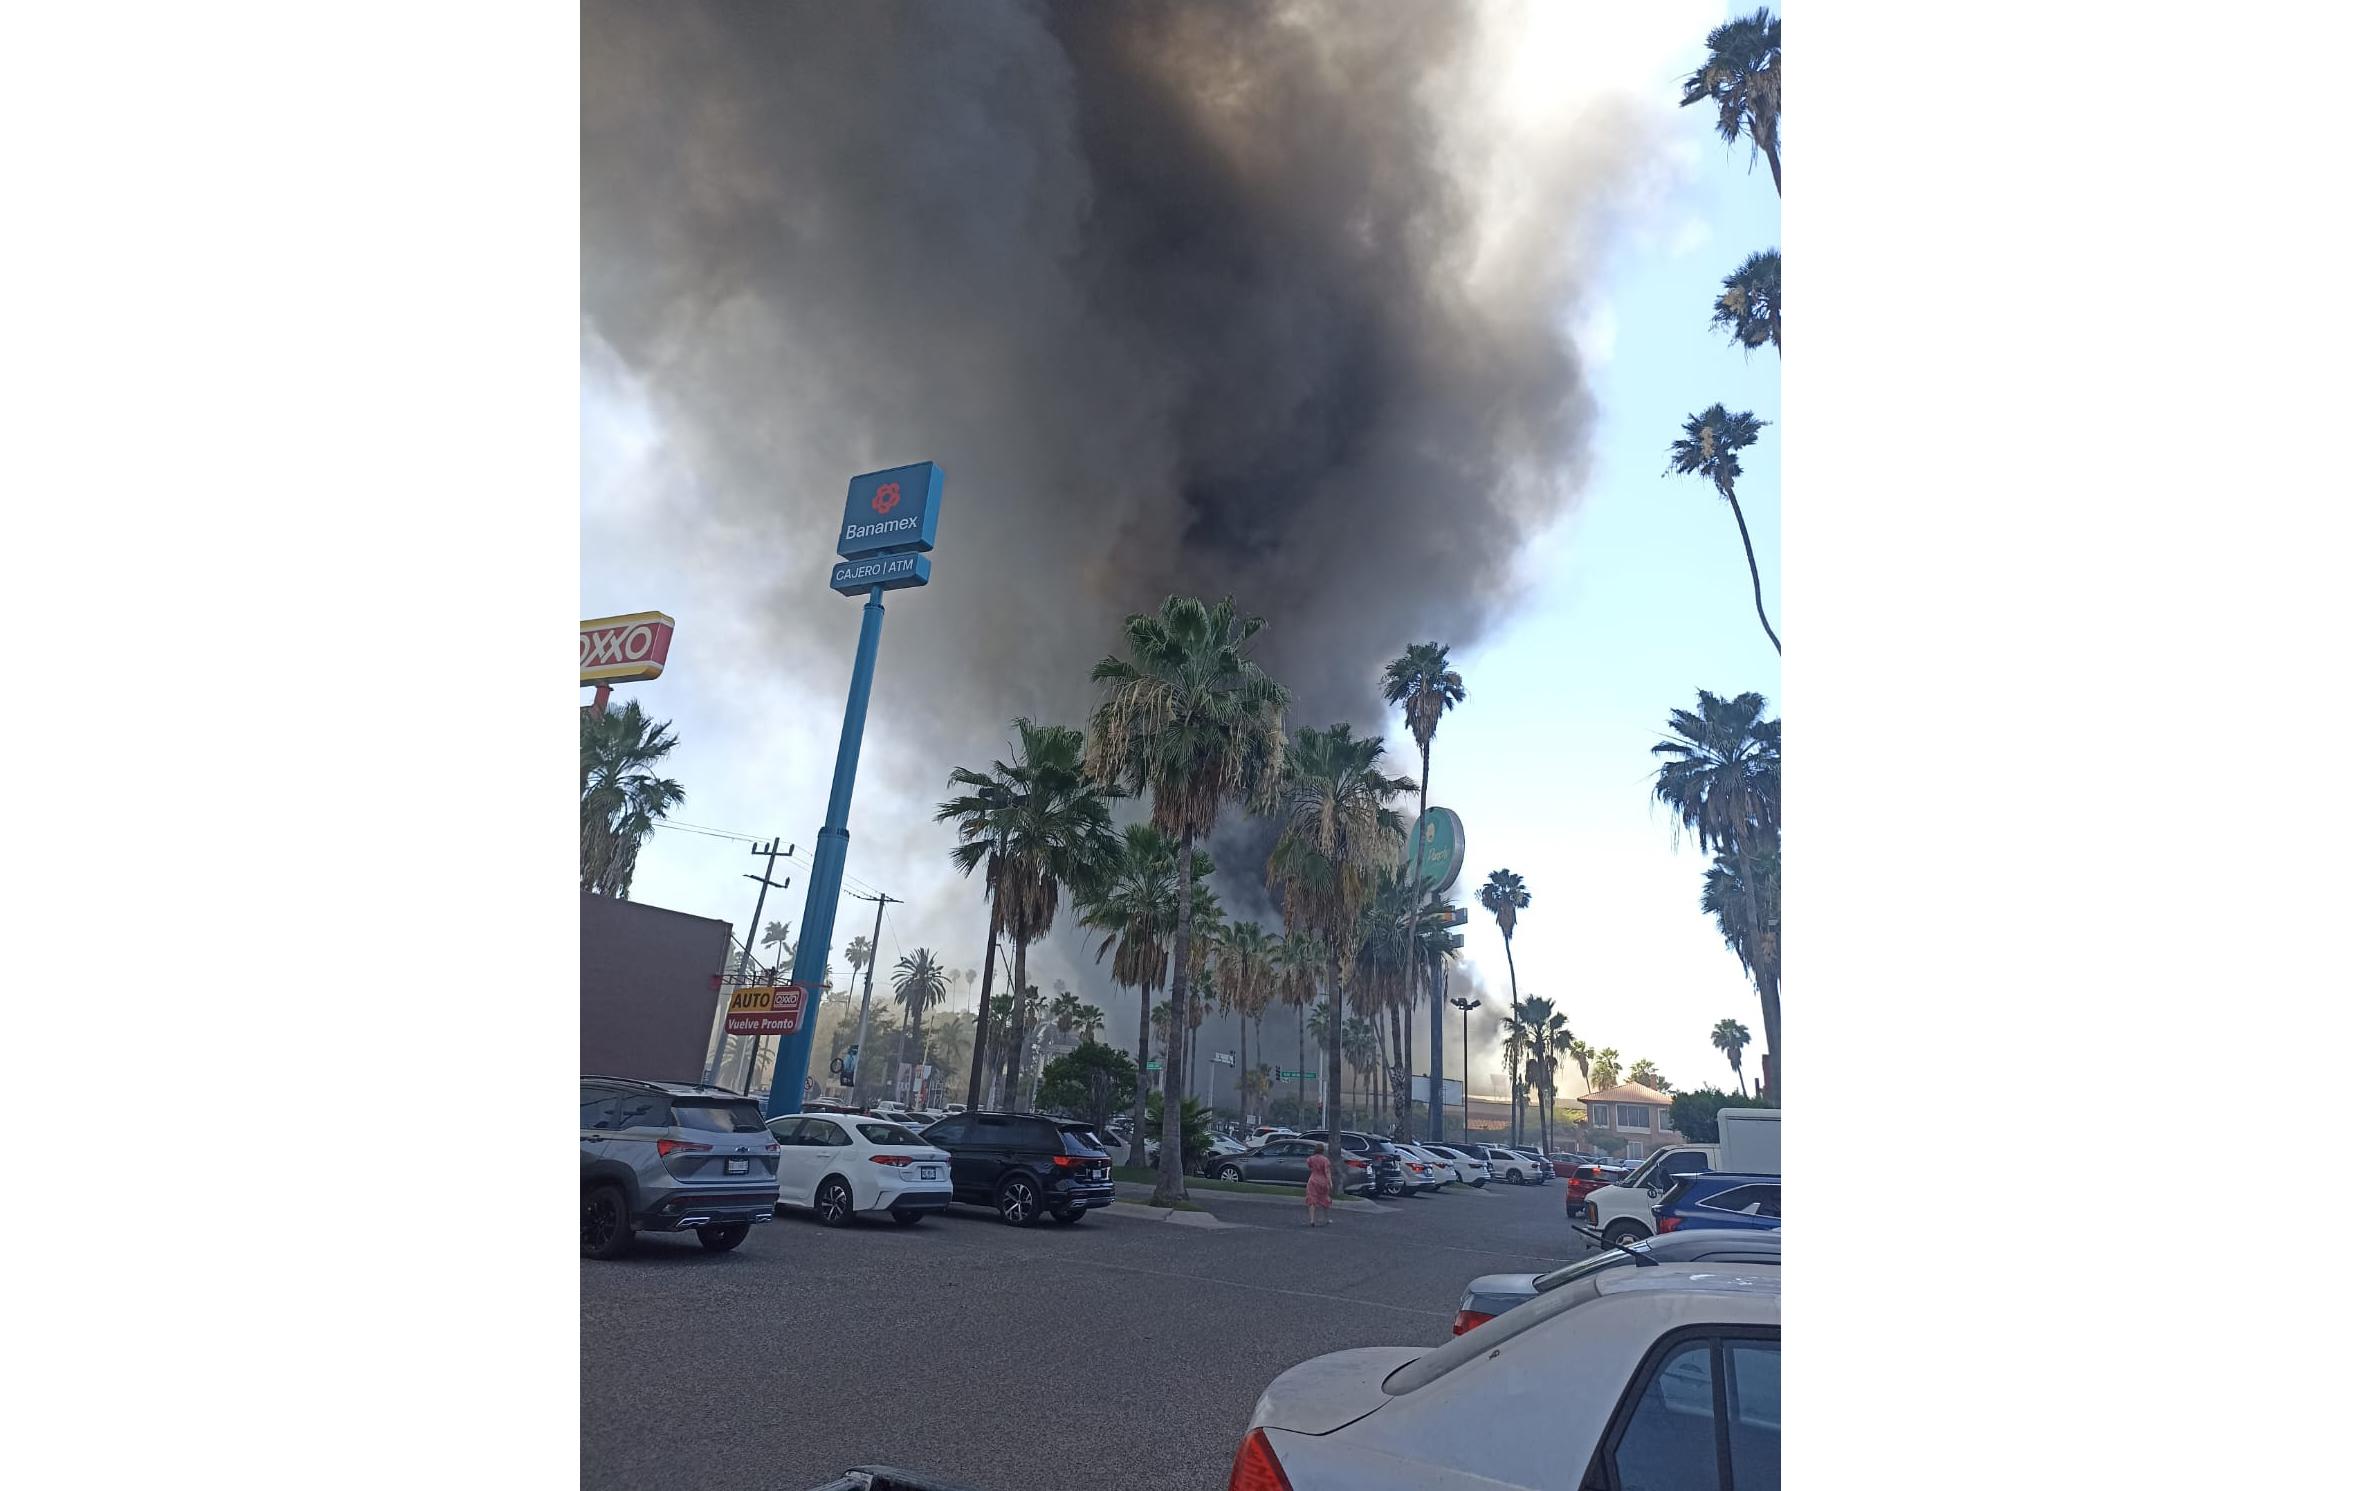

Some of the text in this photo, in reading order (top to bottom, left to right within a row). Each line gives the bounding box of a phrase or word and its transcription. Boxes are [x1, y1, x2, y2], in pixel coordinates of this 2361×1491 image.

[845, 516, 918, 539] Banamex
[836, 565, 881, 581] CAJERO
[888, 559, 914, 574] ATM
[732, 993, 799, 1008] AUTO OXXO
[728, 1018, 794, 1030] Vuelve Pronto
